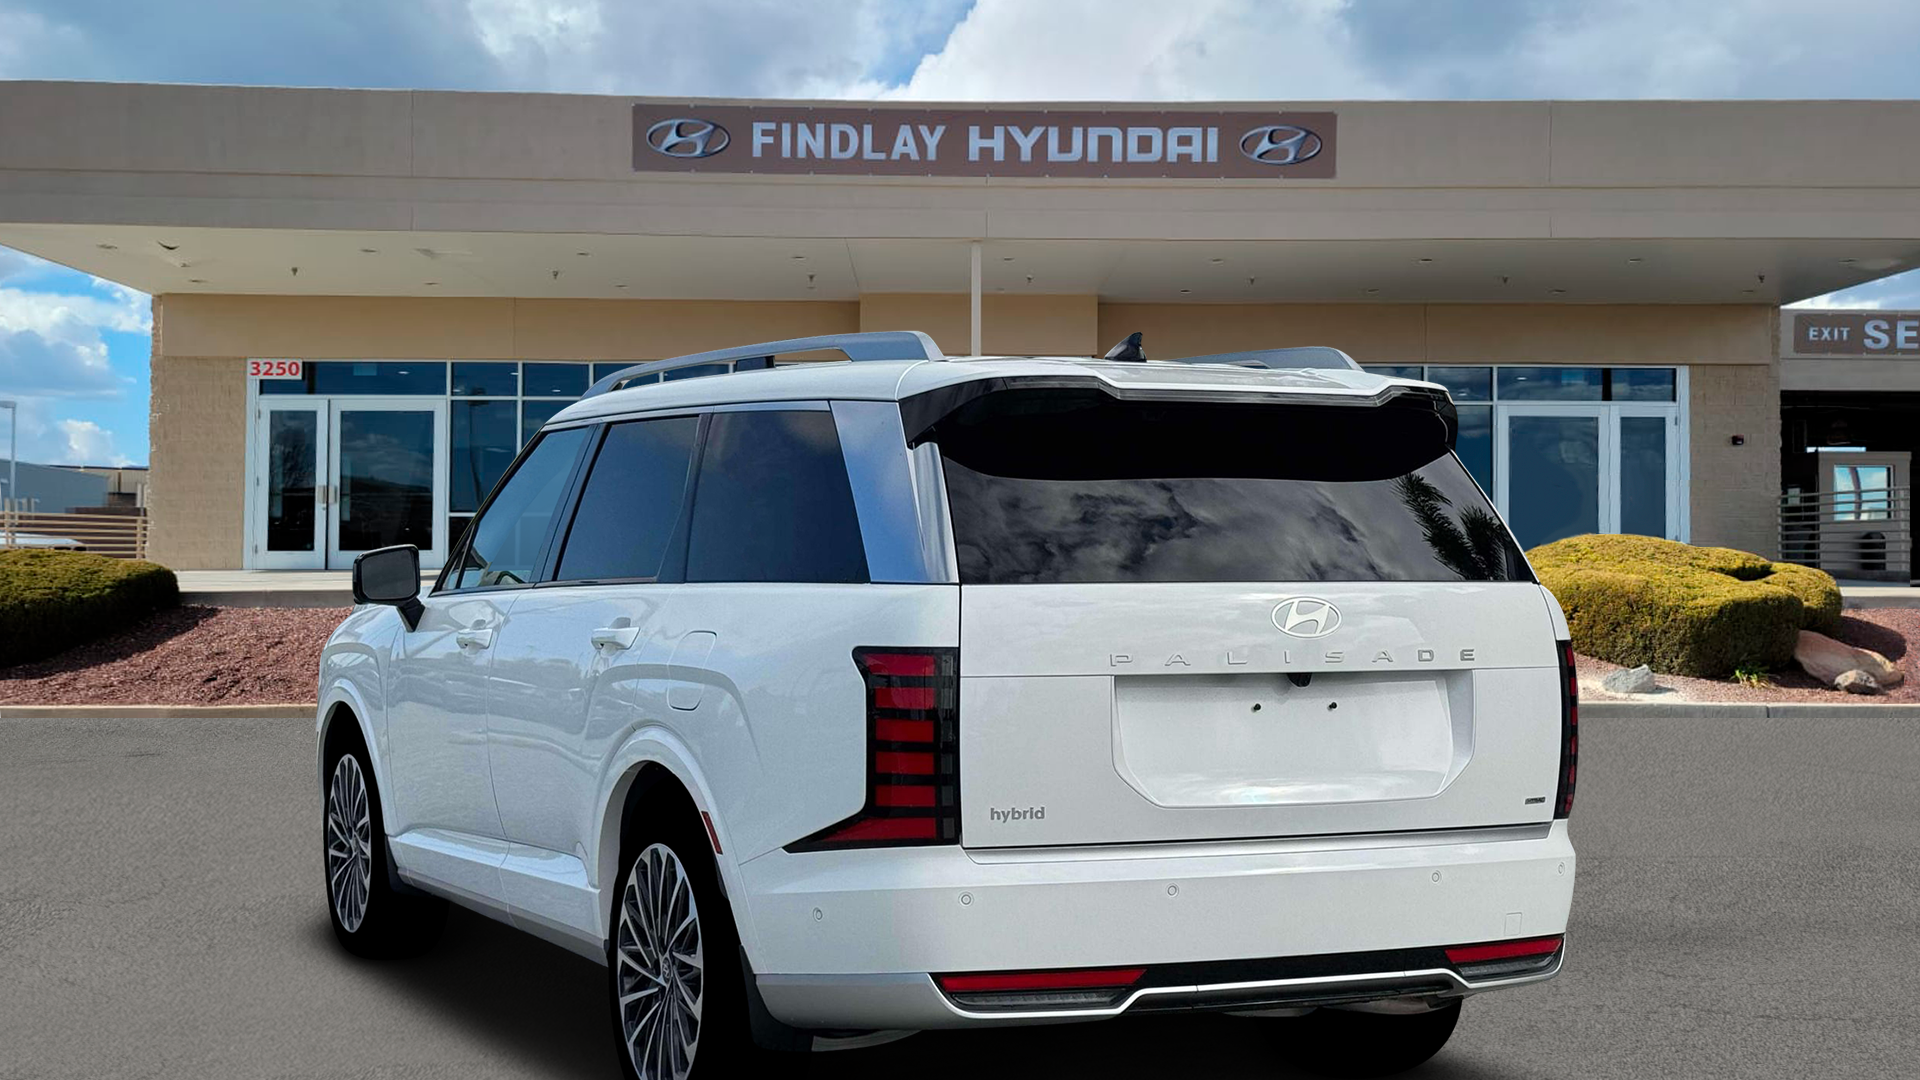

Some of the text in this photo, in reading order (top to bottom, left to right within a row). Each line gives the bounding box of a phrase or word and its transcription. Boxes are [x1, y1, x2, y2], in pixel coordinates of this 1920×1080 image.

[751, 121, 1219, 162] FINDLAY HYUNDAI
[1809, 327, 1850, 341] EXIT
[249, 361, 300, 376] 3250
[1110, 649, 1476, 667] PALISADE
[990, 806, 1045, 824] hybrid
